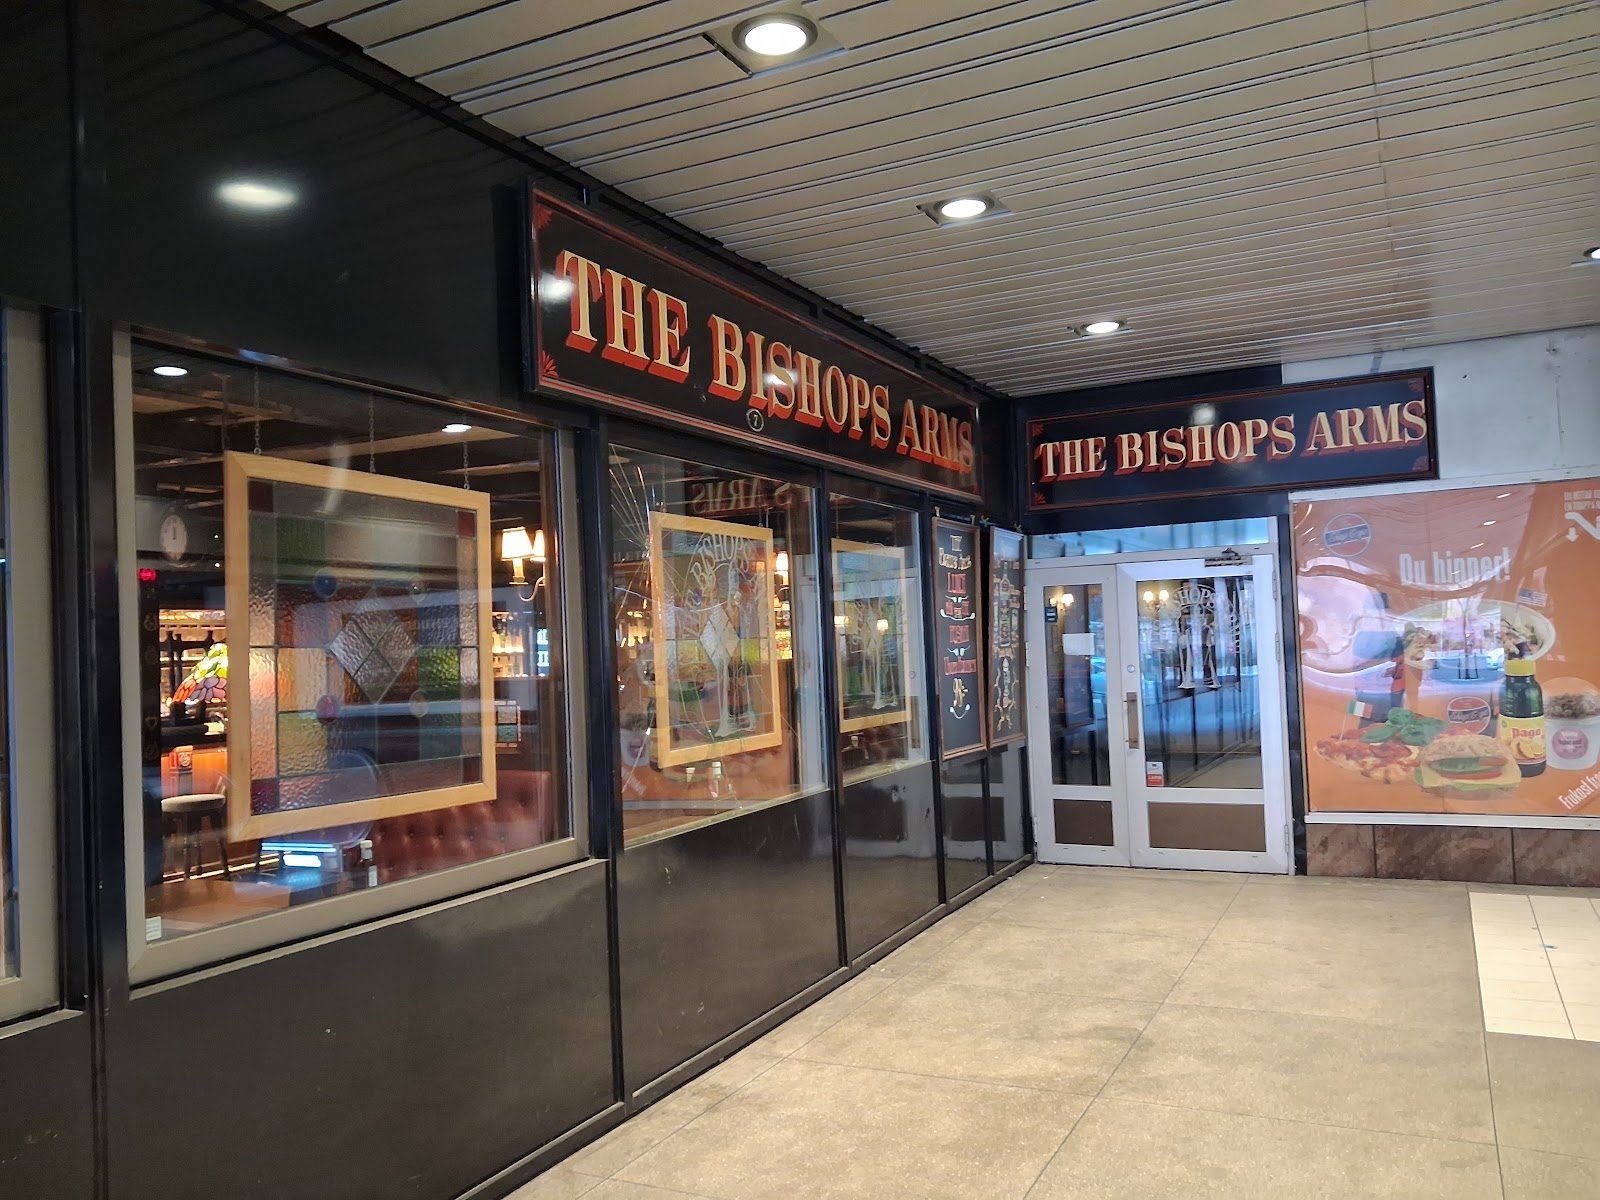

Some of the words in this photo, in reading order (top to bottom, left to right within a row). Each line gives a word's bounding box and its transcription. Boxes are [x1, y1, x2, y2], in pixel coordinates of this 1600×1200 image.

[556, 249, 692, 384] THE
[708, 313, 893, 450] BISHOPS
[896, 398, 974, 475] ARMS
[1035, 435, 1109, 482] THE
[1116, 413, 1297, 475] BISHOPS
[1301, 399, 1429, 457] ARMS
[1400, 552, 1426, 586] Du
[1558, 779, 1592, 810] Frukost
